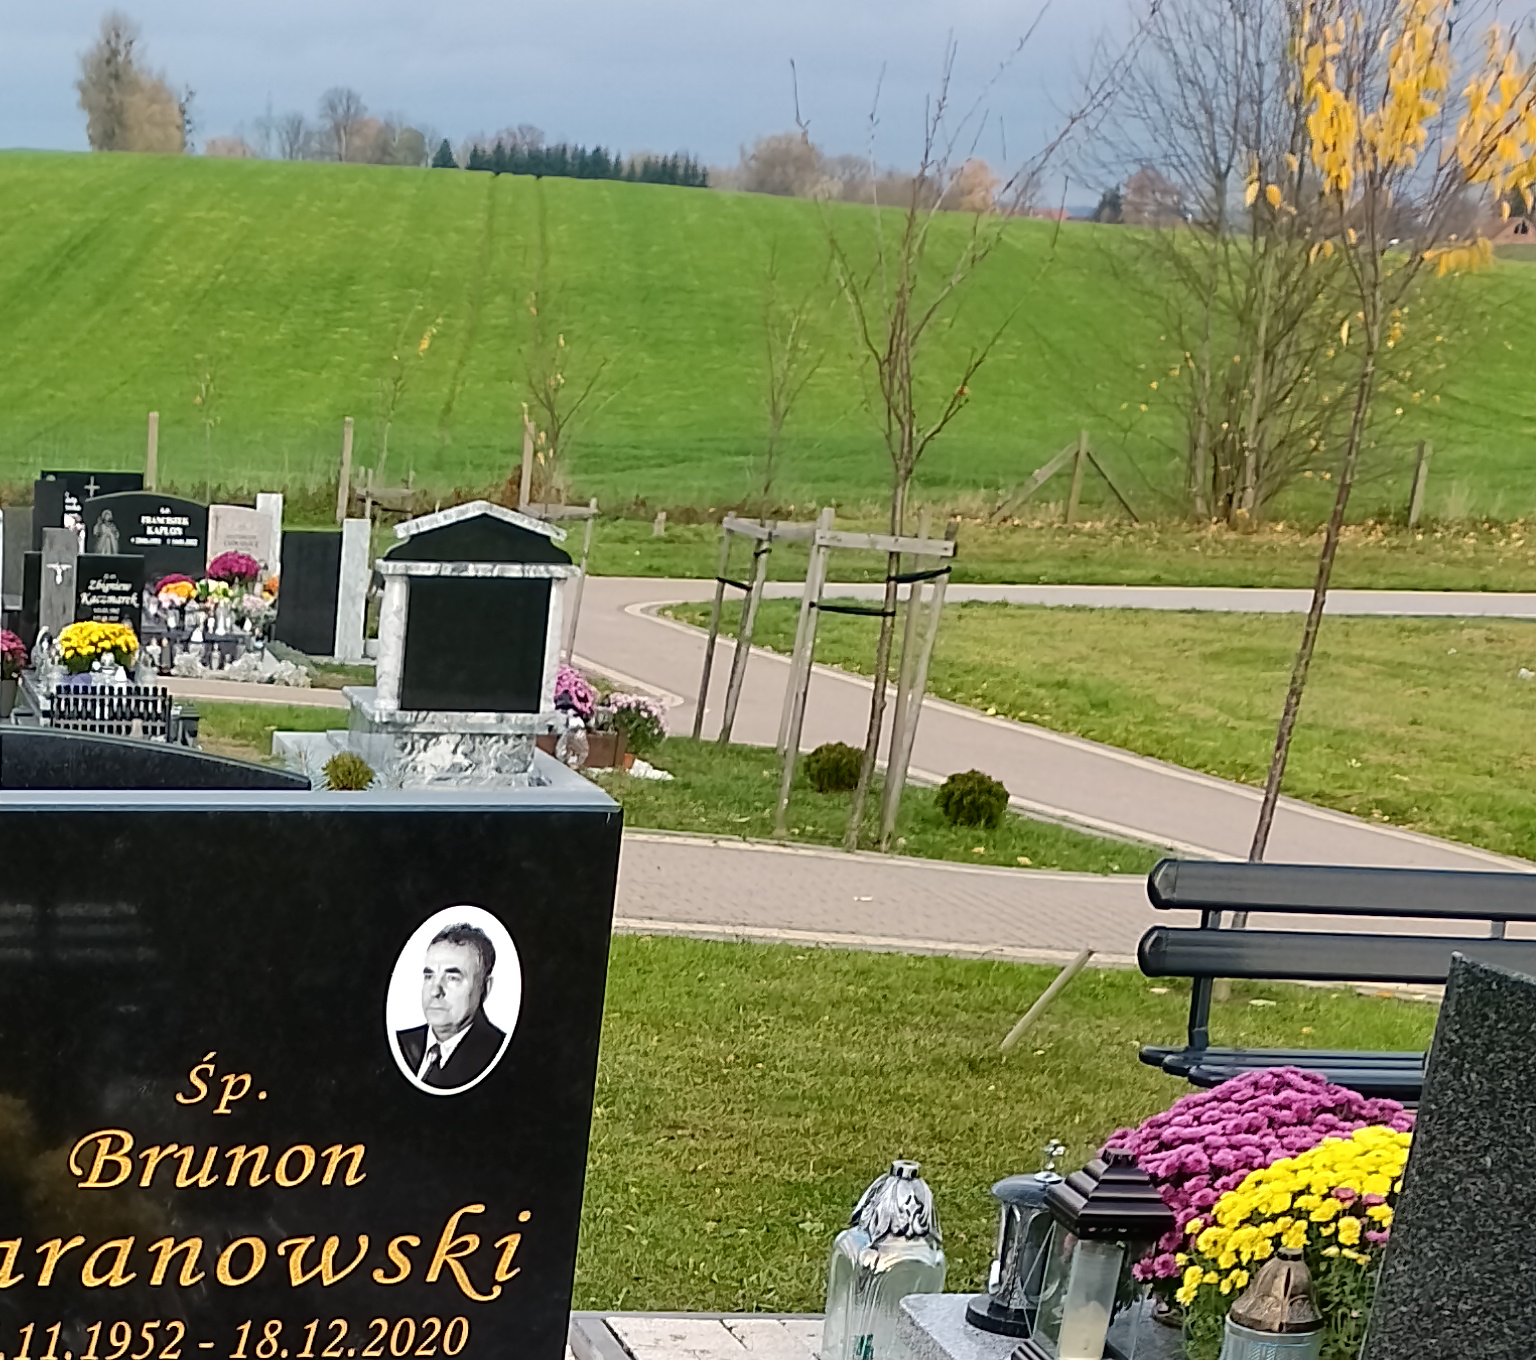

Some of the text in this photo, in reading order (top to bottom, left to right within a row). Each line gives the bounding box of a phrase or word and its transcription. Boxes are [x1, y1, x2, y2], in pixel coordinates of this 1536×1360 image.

[176, 1052, 268, 1114] Śp.
[69, 1129, 366, 1189] Brunon
[229, 1318, 470, 1359] 18.12.2020
